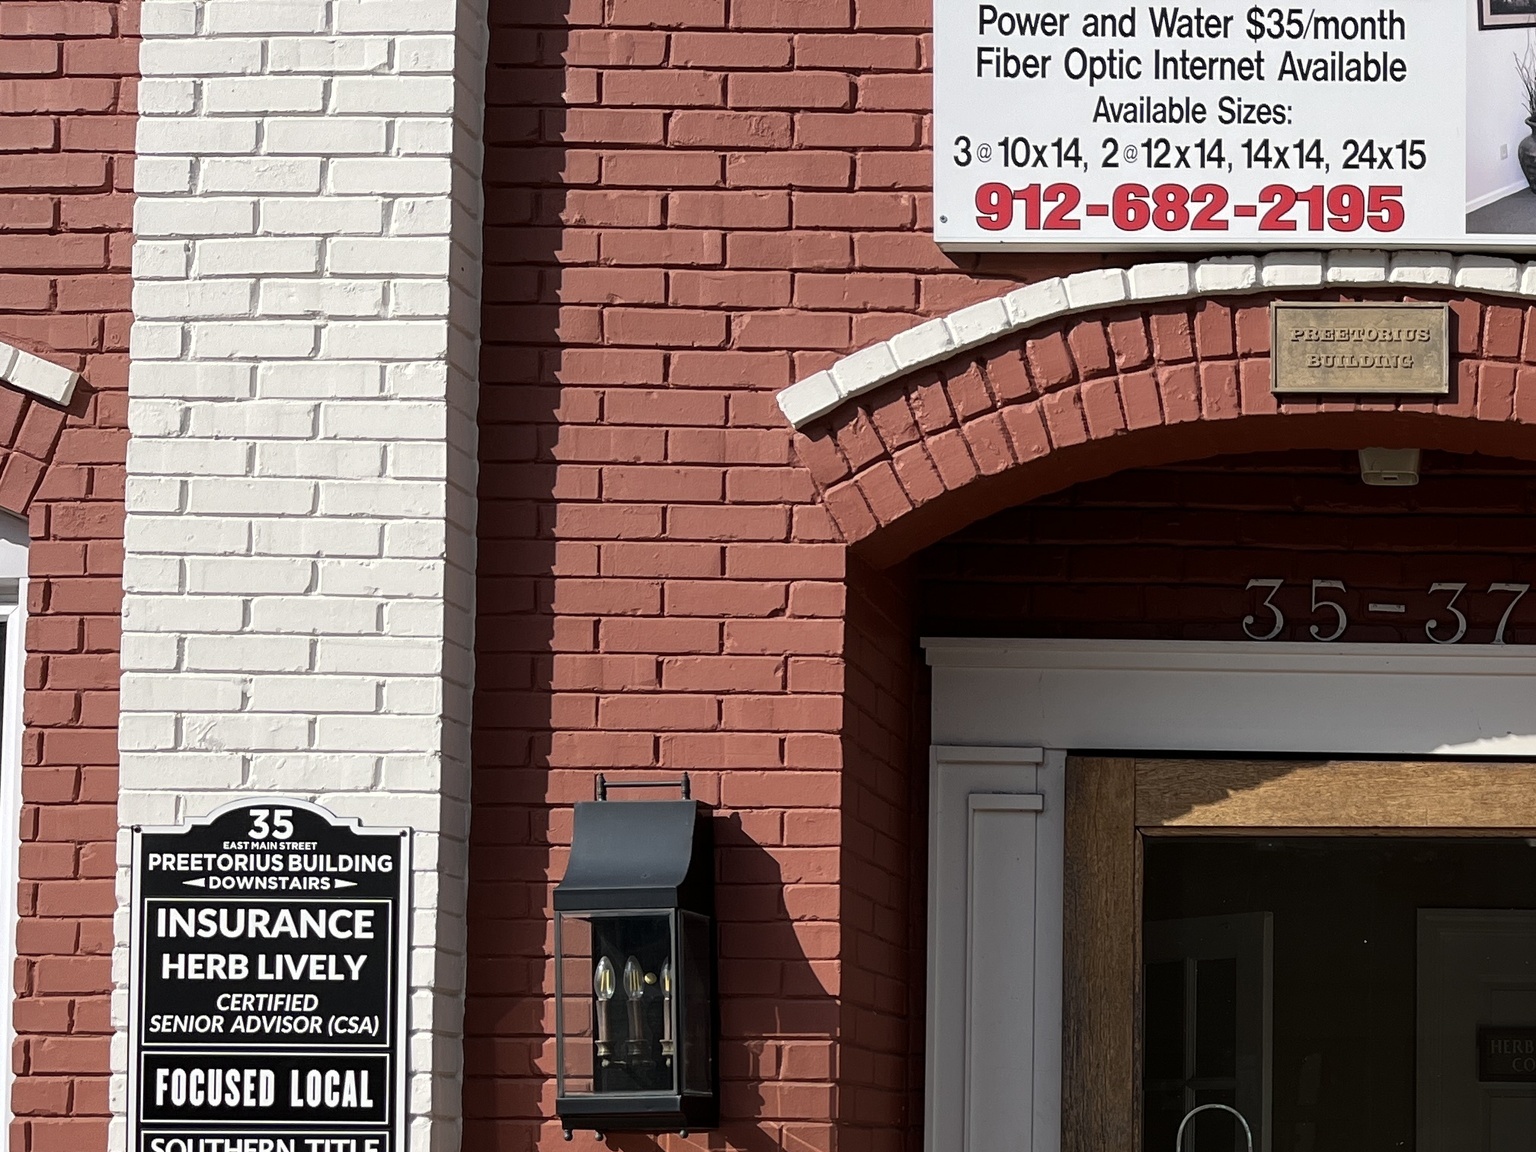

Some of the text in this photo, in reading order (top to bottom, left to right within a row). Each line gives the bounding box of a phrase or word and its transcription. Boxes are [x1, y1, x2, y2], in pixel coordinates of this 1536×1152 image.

[979, 5, 1405, 42] Power and Water $35/month
[977, 47, 1407, 86] Fiber Optic Internet Available
[1093, 96, 1292, 124] Available Sizes:
[1241, 139, 1330, 173] 14x14,
[1342, 139, 1427, 169] 24x15
[975, 182, 1405, 232] 912-682-2195
[1289, 327, 1431, 342] PREETORIUS
[1306, 354, 1414, 369] BUILDING
[1242, 578, 1530, 645] 35-37
[248, 809, 294, 839] 35
[223, 841, 317, 851] EAST MAIN STREET
[148, 853, 393, 872] PREETORIUS BUILDING
[209, 876, 331, 889] DOWNSTAIRS
[157, 908, 374, 939] INSURANCE
[162, 953, 367, 980] HERB LIVELY
[217, 993, 318, 1012] CERTIFIED
[149, 1015, 379, 1036] SENIOR ADVISOR (CSA)
[1491, 1039, 1534, 1054] HERB
[156, 1069, 374, 1108] FOCUSED LOCAL
